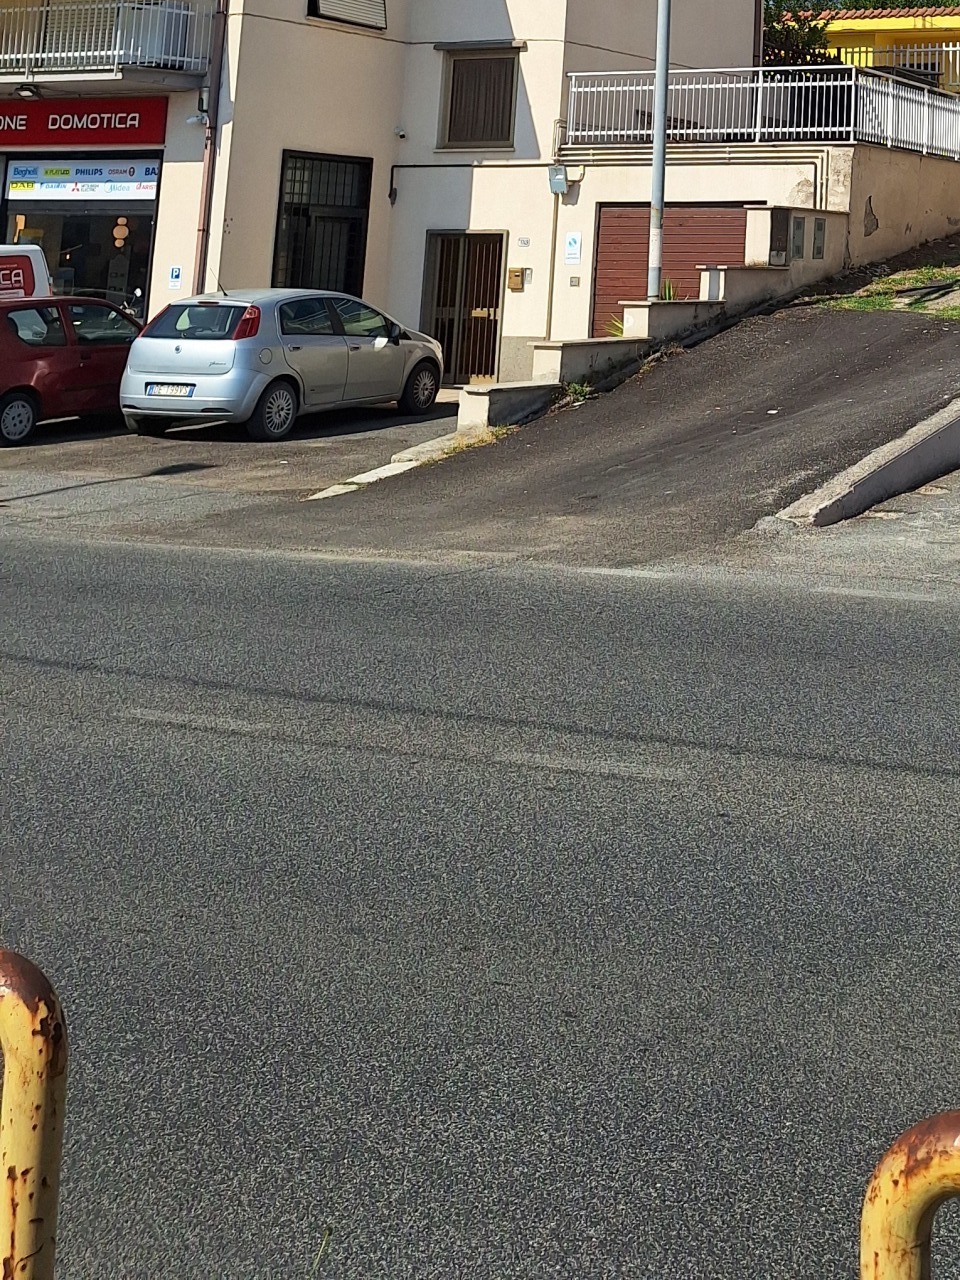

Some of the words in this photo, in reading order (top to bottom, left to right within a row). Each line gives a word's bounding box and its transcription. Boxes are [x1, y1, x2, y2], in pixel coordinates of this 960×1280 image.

[0, 115, 28, 130] NE
[48, 113, 140, 129] DOMOTICA
[75, 168, 103, 176] PHILIPS
